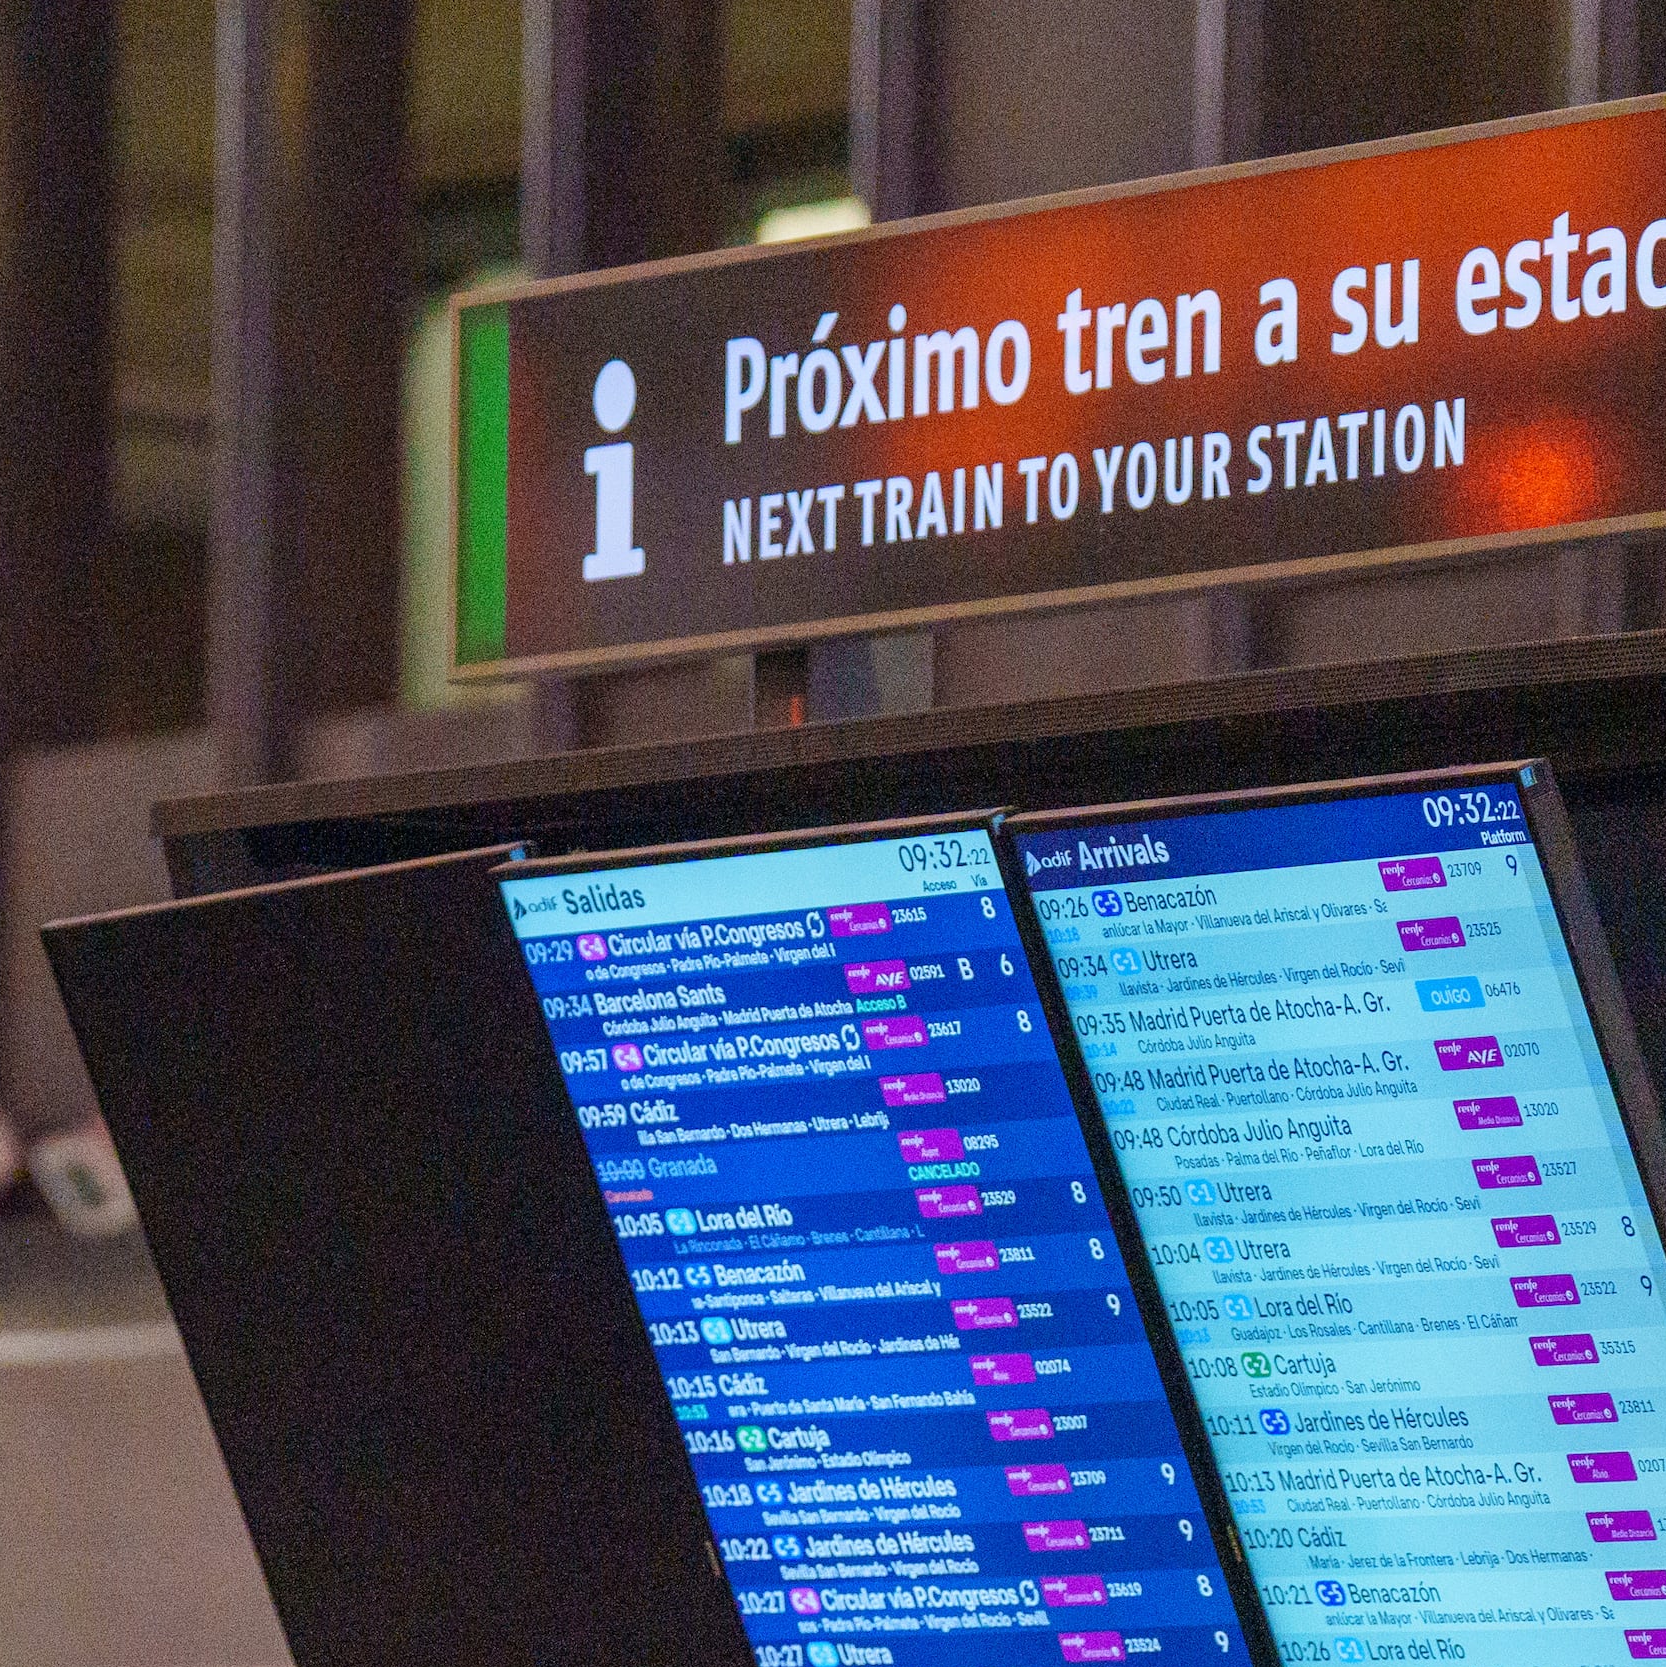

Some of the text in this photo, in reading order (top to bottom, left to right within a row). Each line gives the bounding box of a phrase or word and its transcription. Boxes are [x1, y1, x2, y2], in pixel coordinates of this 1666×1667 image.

[724, 303, 1032, 444] Próximo
[1059, 279, 1222, 395] tren
[1255, 279, 1299, 367] a
[1332, 258, 1421, 357] su
[721, 397, 1468, 566] NEXT TRAIN TO YOUR STATION
[1041, 792, 1520, 871] adif Arrivals 09:32:22
[1480, 829, 1526, 845] Platform
[527, 839, 990, 915] adif Salidas 09:32:22
[922, 874, 988, 892] Acceso Vía
[1037, 896, 1089, 923] 09:26
[1123, 884, 1217, 913] Benacazón
[1382, 864, 1405, 876] renfe
[1447, 861, 1482, 878] 23709
[1505, 854, 1518, 876] 9
[525, 940, 573, 965] 09:29
[608, 930, 672, 957] Circular
[674, 926, 702, 950] vía
[700, 921, 805, 947] P.Congresos
[892, 907, 927, 924] 23615
[980, 896, 996, 919] 8
[1056, 955, 1108, 980] 09:34
[1141, 950, 1198, 972] Utrera
[1465, 921, 1502, 938] 23525
[543, 953, 1014, 1019] 09:34 Barcelona Sants AVE 02591 B 6
[1166, 962, 1373, 993] Jardines de Hércules Virgen del Rocío
[856, 994, 907, 1013] Acceso B
[1075, 1012, 1126, 1037] 09:35
[1128, 1006, 1189, 1032] Madrid
[1189, 1005, 1247, 1027] Puerta
[1249, 1000, 1272, 1022] de
[1275, 993, 1361, 1020] Atocha-A.
[1363, 991, 1390, 1013] Gr.
[1484, 981, 1521, 997] 06476
[1137, 1033, 1256, 1054] Córdoba Julio Anguita
[578, 1077, 980, 1128] 09:59 Cádiz 13020
[1156, 1080, 1418, 1112] Ciudad Real Puertollano Córdoba Julio Anguita
[1110, 1101, 1559, 1153] 09:48 Córdoba Julio Anguita 13020
[648, 1134, 999, 1178] Granada 08295
[908, 1162, 980, 1181] CANCELADO
[1174, 1139, 1424, 1170] Posadas Palma del Río Peñaflor Lora del Río
[611, 1181, 1086, 1237] 10:05 Lora del Río 23529 8
[632, 1238, 1104, 1291] 10:12 Benacazón 23811 8
[1148, 1242, 1201, 1268] 10:04
[1235, 1240, 1291, 1261] Utrera
[1560, 1220, 1597, 1236] 23529
[1621, 1215, 1636, 1237] 8
[1185, 1356, 1238, 1381] 10:08
[1273, 1352, 1337, 1376] Cartuja
[1599, 1340, 1636, 1355] 35315
[1249, 1378, 1421, 1399] Estadio Olímpico San Jerónimo
[1204, 1415, 1257, 1437] 10:11
[1294, 1410, 1365, 1433] Jardines
[1367, 1409, 1390, 1430] de
[1390, 1406, 1469, 1429] Hércules
[1618, 1400, 1655, 1414] 23811
[1242, 1527, 1293, 1550] 10:20
[1297, 1526, 1346, 1548] Cádiz
